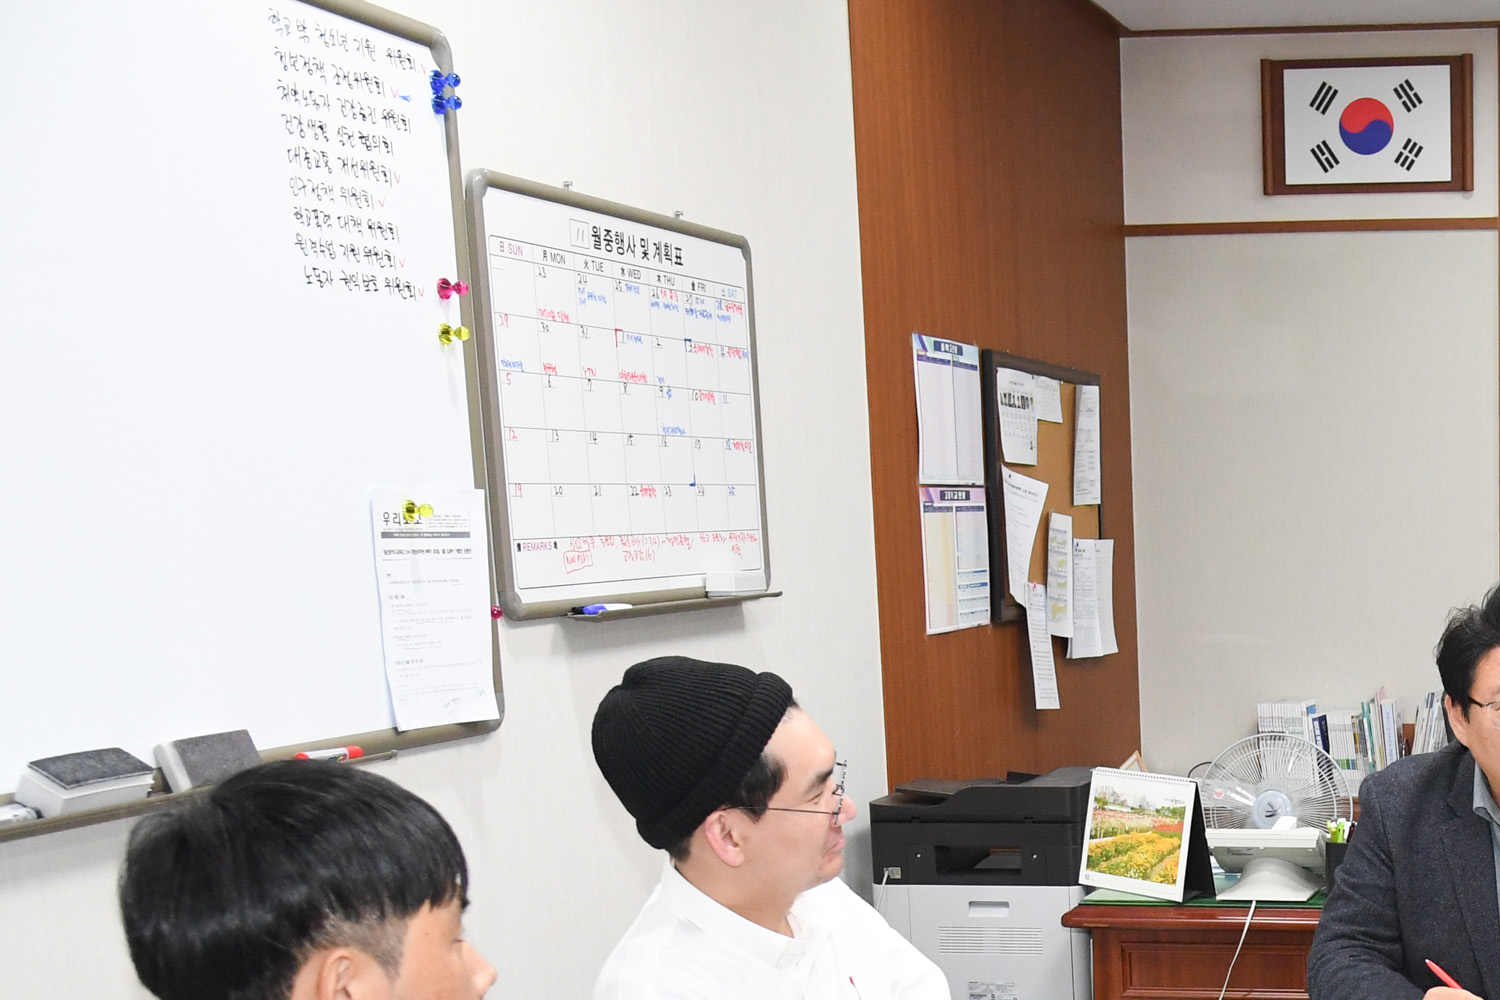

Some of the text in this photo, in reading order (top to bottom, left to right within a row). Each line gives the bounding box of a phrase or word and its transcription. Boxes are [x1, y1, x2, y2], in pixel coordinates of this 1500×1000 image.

[268, 8, 291, 36] 학교
[315, 23, 349, 52] 청소년
[353, 37, 377, 62] 지원
[331, 63, 386, 98] 조정위원회
[276, 79, 412, 134] 취약노동자 건강증진 위원회
[281, 113, 395, 157] 건강생활 실천 협의회
[287, 145, 393, 188] 대중교통 개선위원회
[289, 175, 374, 210] 인구정책 위원회
[293, 205, 400, 243] 학교폭력 대책 위원회
[294, 232, 397, 270] 원격수업 지원 위원회
[507, 243, 524, 256] SUN
[591, 225, 637, 258] 월중행사
[640, 237, 650, 261] 및
[653, 240, 684, 267] 계획표
[550, 252, 566, 265] MON
[538, 266, 546, 278] 23
[591, 260, 604, 272] TUE
[628, 268, 642, 280] WED
[663, 275, 676, 286] THU
[304, 265, 417, 301] 노동자 권익보호 위원회
[697, 282, 707, 292] FRI
[500, 314, 508, 328] 29
[541, 322, 549, 332] 30
[508, 427, 517, 439] 12
[554, 486, 563, 496] 20
[522, 541, 552, 552] REMARKS
